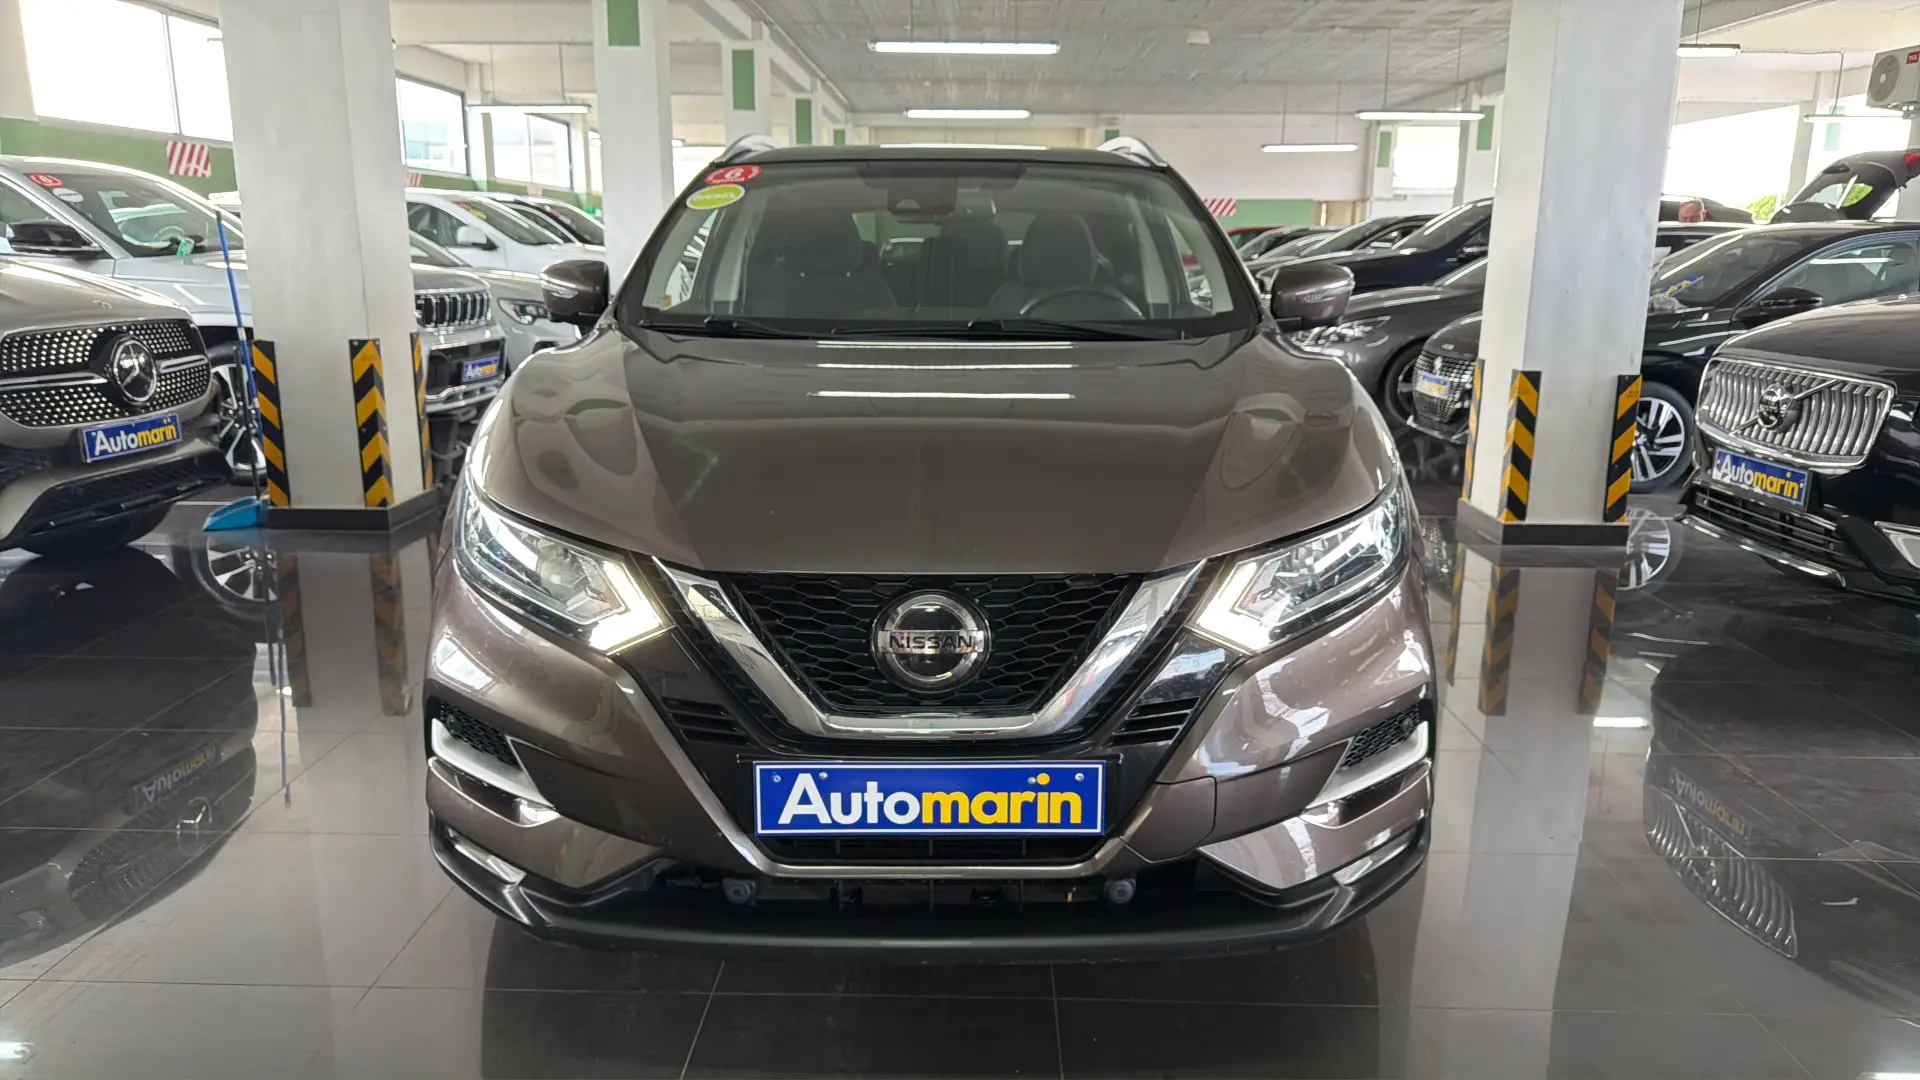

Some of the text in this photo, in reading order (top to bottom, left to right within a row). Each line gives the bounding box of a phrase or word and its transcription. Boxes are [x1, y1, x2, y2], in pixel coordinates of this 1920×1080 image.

[94, 418, 177, 456] Automarin
[1719, 455, 1799, 500] Automarin
[890, 635, 972, 649] NISSAN
[778, 772, 1082, 825] Automarin
